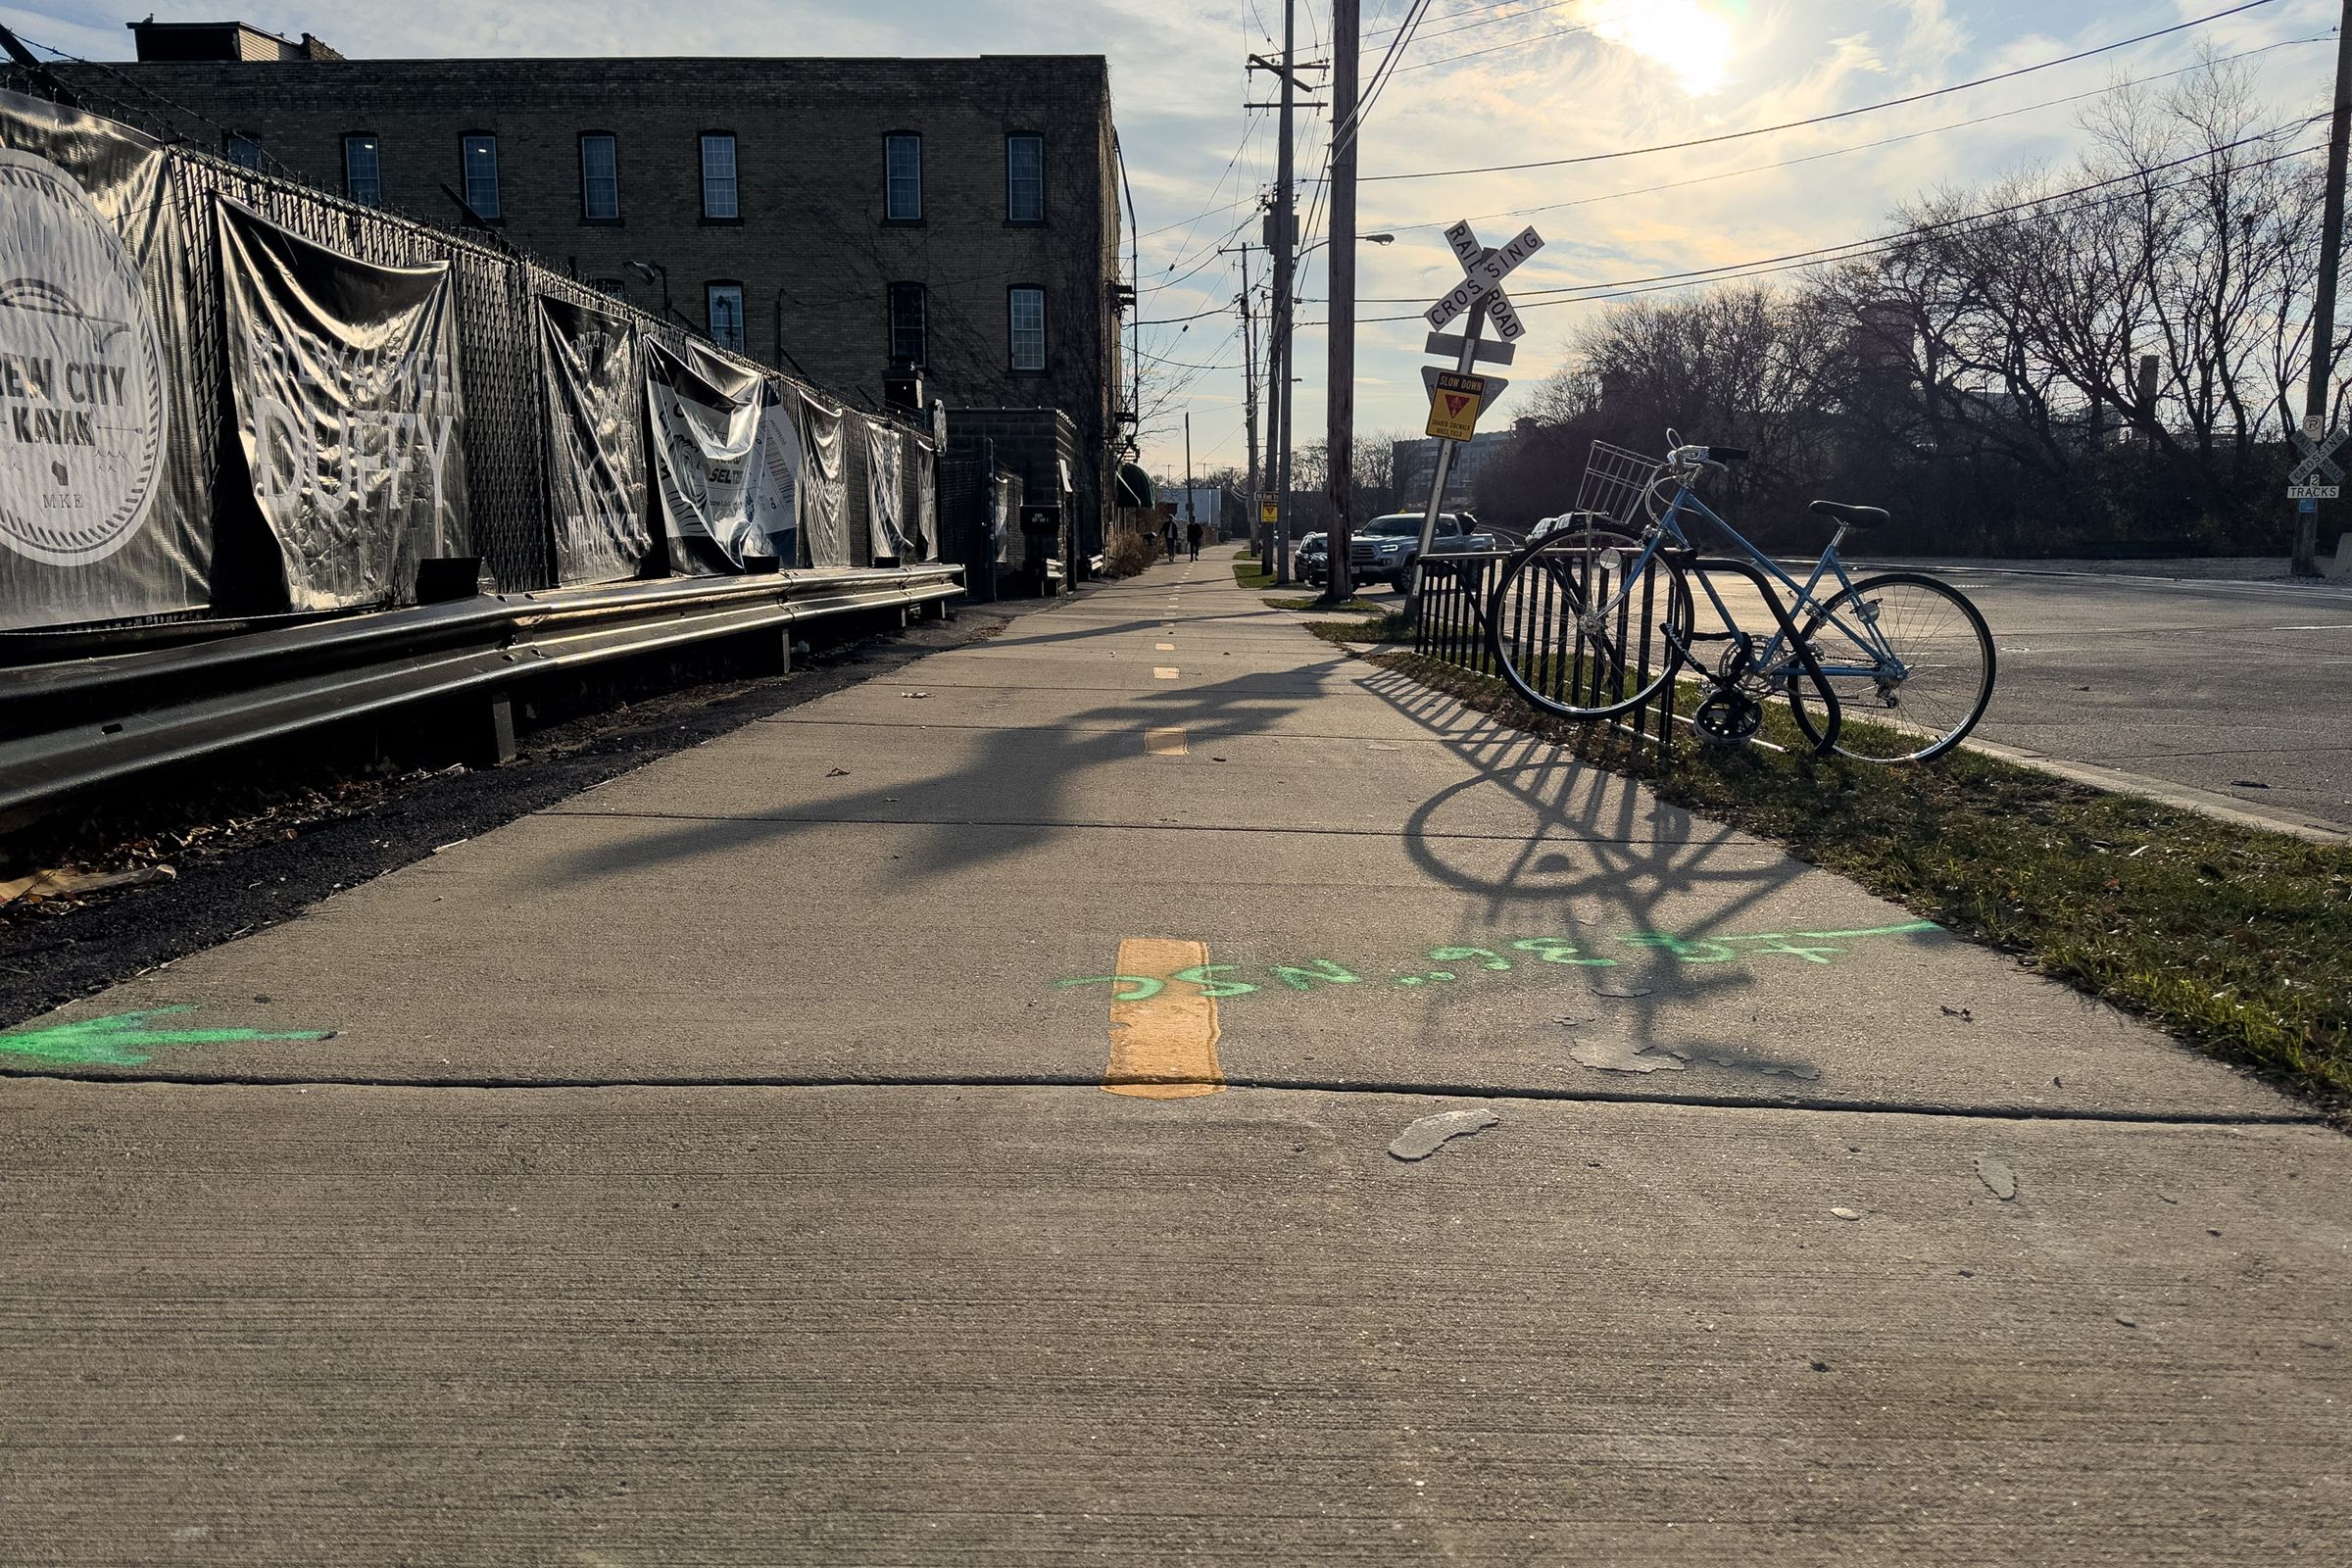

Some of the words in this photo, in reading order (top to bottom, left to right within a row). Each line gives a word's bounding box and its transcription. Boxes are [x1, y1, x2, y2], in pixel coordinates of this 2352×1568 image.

[1431, 232, 1538, 324] CROSSING
[1449, 224, 1482, 273] RAIL
[1487, 288, 1519, 338] ROAD
[65, 362, 125, 407] CITY
[1440, 375, 1459, 389] SLOW
[1461, 379, 1482, 391] DOWN
[12, 406, 96, 446] KAYAK
[253, 396, 453, 512] DUFFY
[2294, 433, 2343, 480] CROSSING
[2321, 458, 2342, 480] ROAD
[2290, 487, 2336, 497] TRACKS
[2311, 475, 2319, 487] 2
[42, 494, 84, 509] MKE
